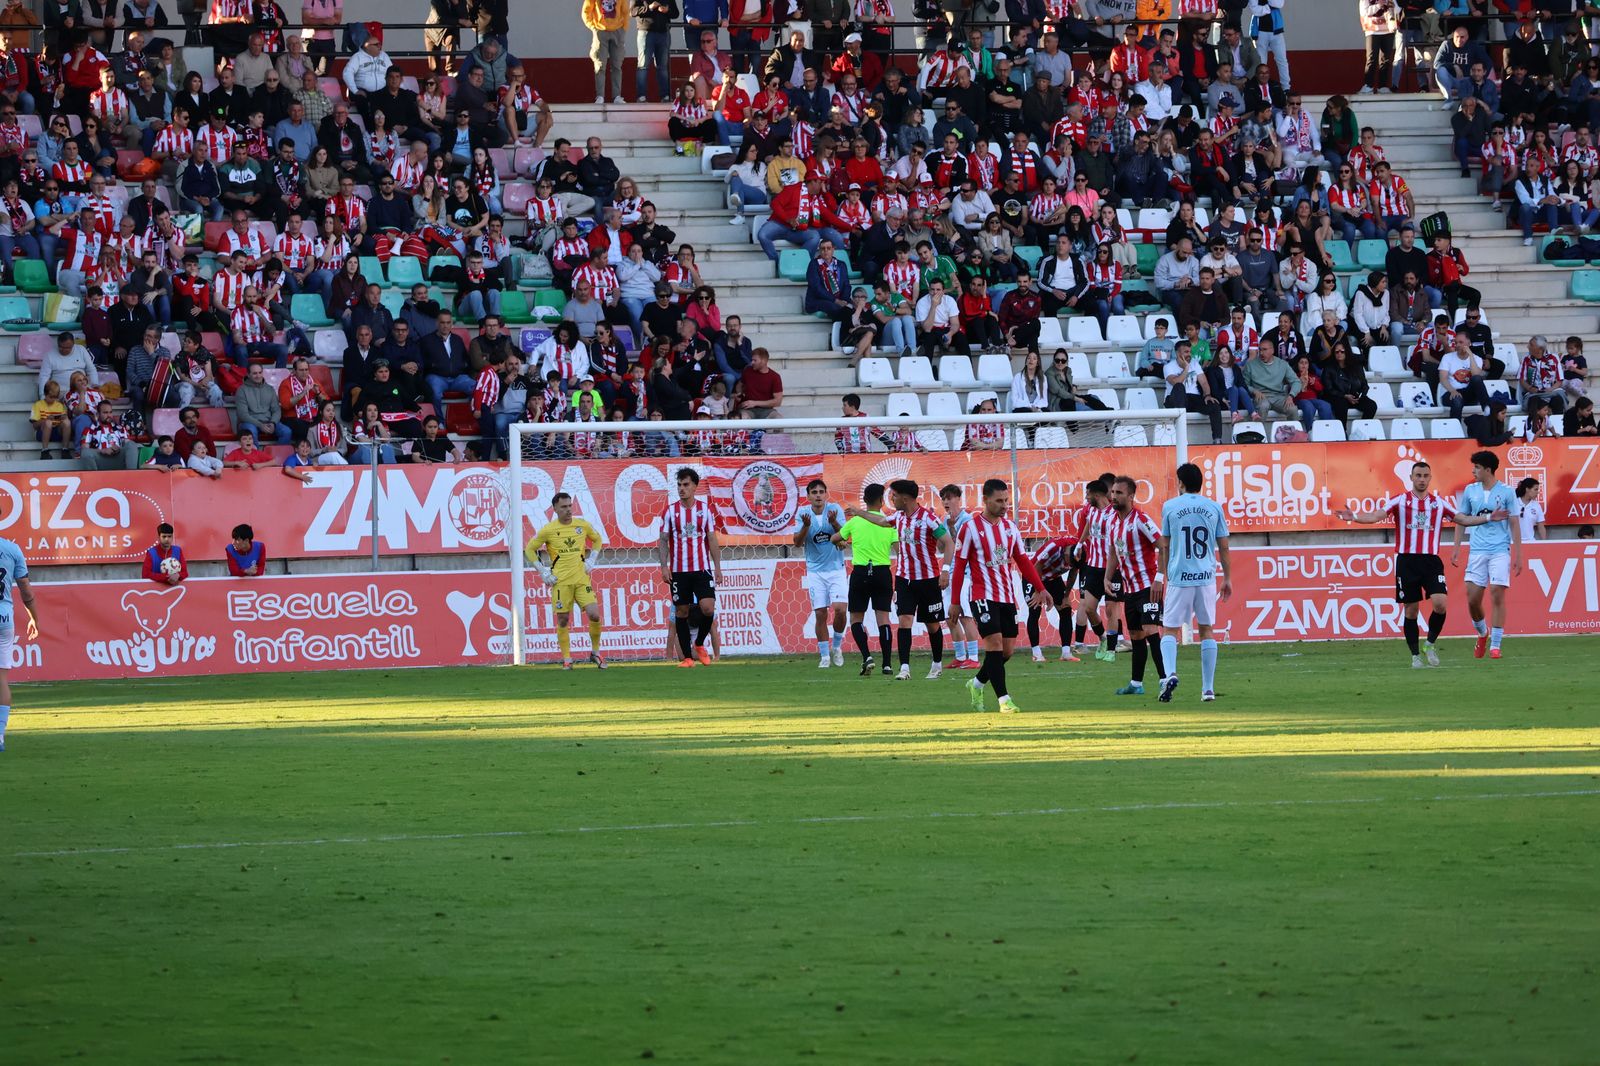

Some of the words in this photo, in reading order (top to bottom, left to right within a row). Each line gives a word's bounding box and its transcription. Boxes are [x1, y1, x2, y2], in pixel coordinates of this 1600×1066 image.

[746, 465, 782, 476] FONDO
[1214, 450, 1315, 503] fisio
[1219, 486, 1332, 523] readapt
[1177, 507, 1192, 519] JOEL
[1225, 516, 1299, 526] OLICLÍNICA
[25, 534, 132, 549] JAMONES
[1181, 526, 1209, 559] 18
[630, 580, 654, 595] del
[672, 582, 678, 593] 5
[227, 584, 418, 621] Escuela
[719, 594, 755, 610] VINOS
[974, 599, 989, 614] 14
[233, 624, 421, 664] infantil
